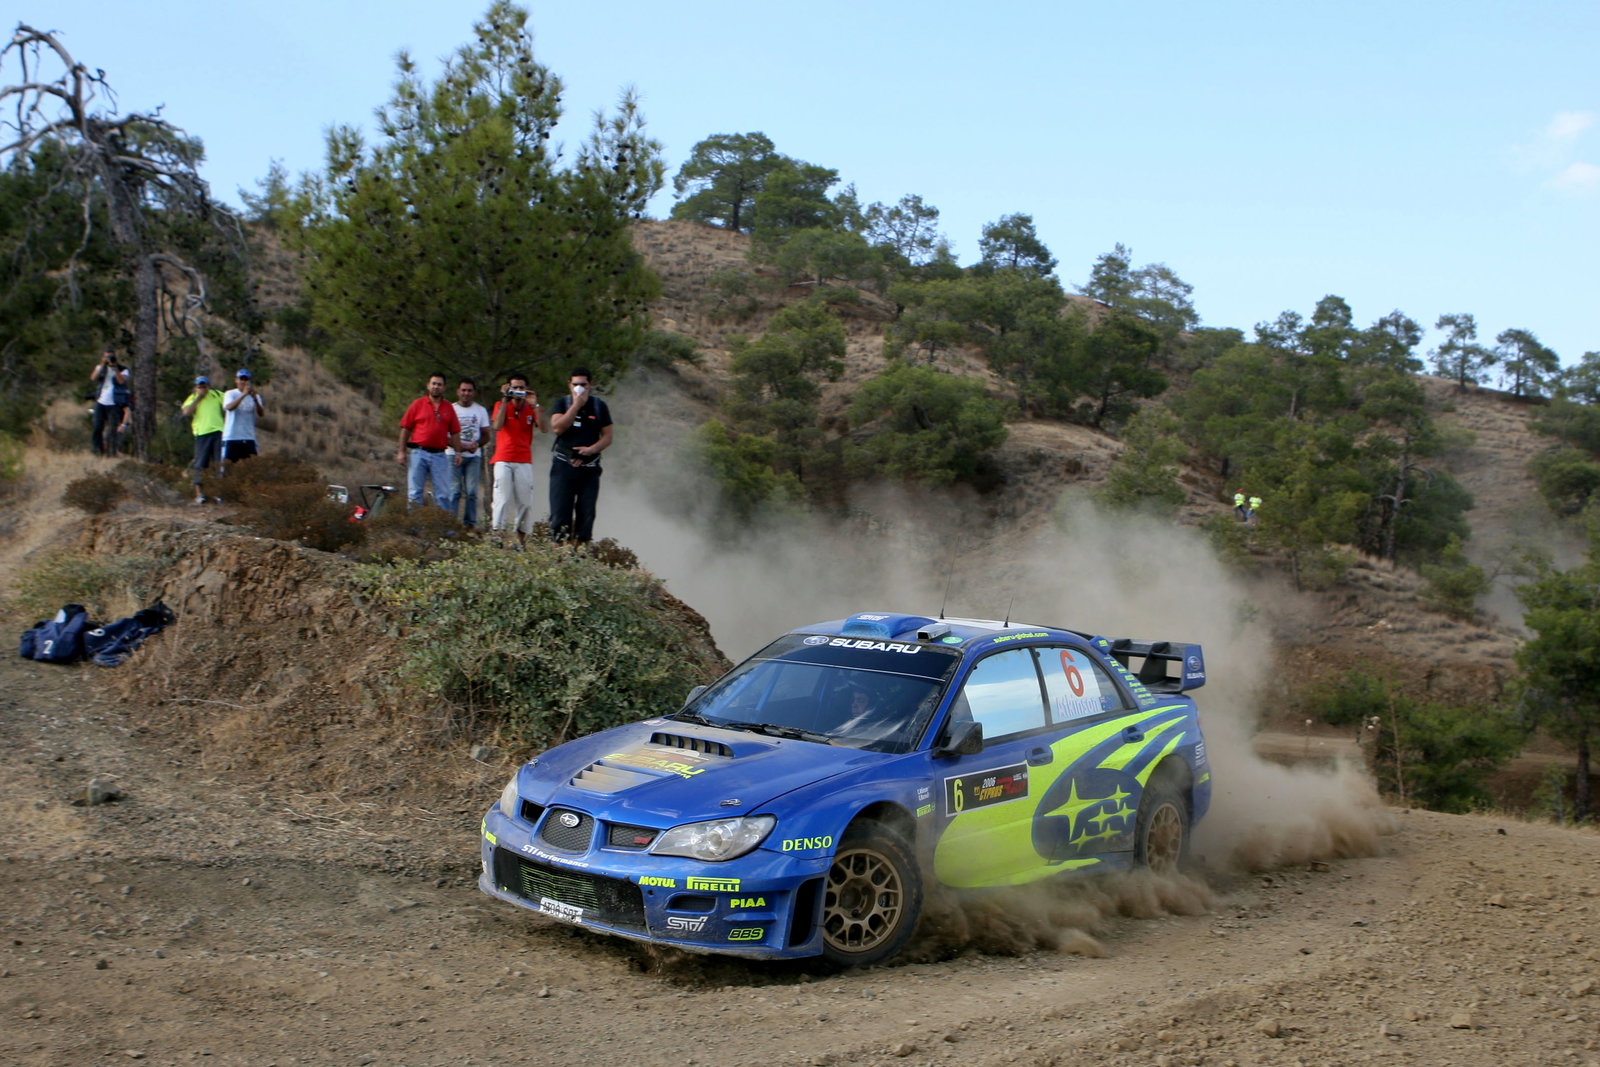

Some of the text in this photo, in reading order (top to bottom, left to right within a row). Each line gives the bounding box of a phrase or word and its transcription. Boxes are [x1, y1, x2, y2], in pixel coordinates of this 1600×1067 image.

[42, 640, 54, 655] 2
[829, 638, 922, 654] SUBARU
[1060, 650, 1085, 697] 6
[953, 778, 964, 812] 6
[782, 835, 833, 852] DENSO
[638, 876, 676, 888] MOTUL
[687, 876, 741, 892] PIRELLI
[730, 897, 766, 909] PIAA
[729, 928, 763, 940] BBS
